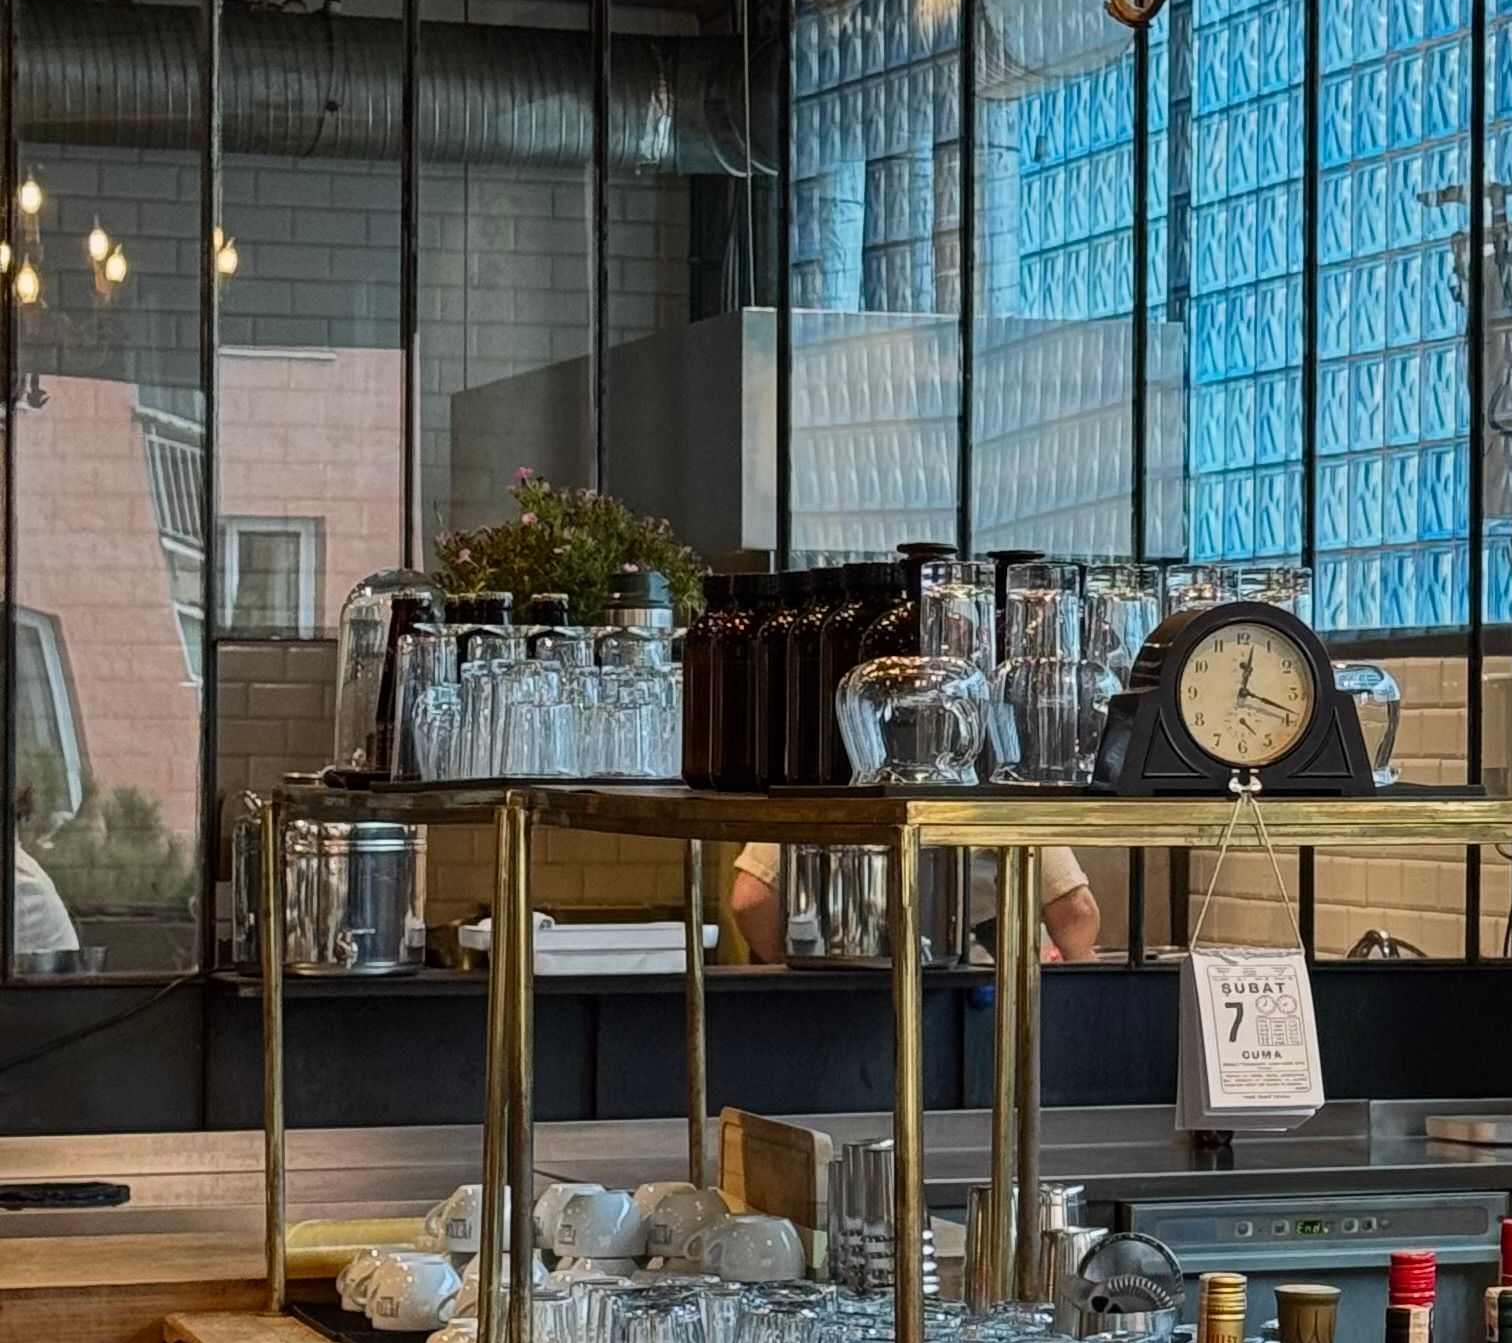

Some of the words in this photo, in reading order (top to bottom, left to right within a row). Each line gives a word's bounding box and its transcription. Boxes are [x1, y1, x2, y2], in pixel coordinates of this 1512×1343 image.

[1236, 632, 1251, 645] 12
[1214, 639, 1224, 653] 11
[1195, 660, 1208, 673] 10
[1281, 660, 1292, 674] 2
[1187, 685, 1198, 700] 9
[1288, 687, 1298, 701] 3
[1194, 712, 1205, 727] 8
[1212, 733, 1221, 747] 7
[1237, 739, 1248, 754] 6
[1262, 733, 1272, 747] 5
[1221, 982, 1286, 997] ŞUBAT
[1224, 1002, 1244, 1043] 7
[1241, 1050, 1283, 1060] CUMA
